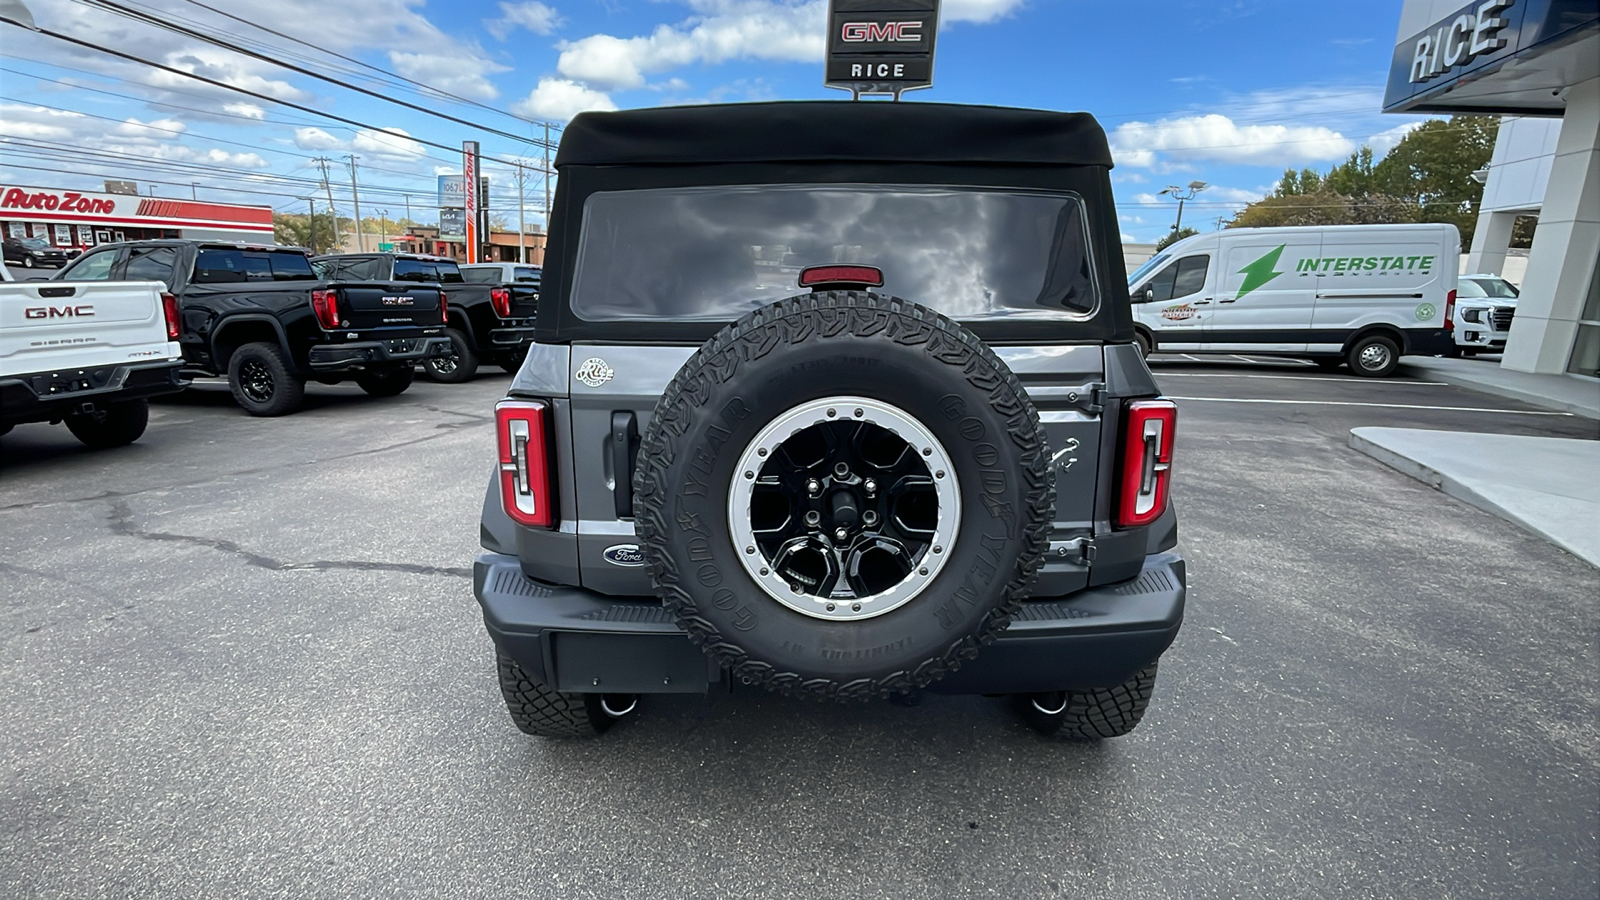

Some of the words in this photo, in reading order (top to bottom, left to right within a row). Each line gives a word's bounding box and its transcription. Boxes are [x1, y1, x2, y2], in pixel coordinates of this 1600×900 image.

[842, 22, 922, 42] GMC
[1409, 0, 1513, 83] RICE
[851, 64, 904, 77] RICE
[466, 149, 474, 211] AutoZone
[1, 187, 115, 214] AutoZone
[1296, 256, 1435, 272] INTERSTATE
[25, 305, 95, 319] GMC
[31, 337, 96, 346] SIERRA
